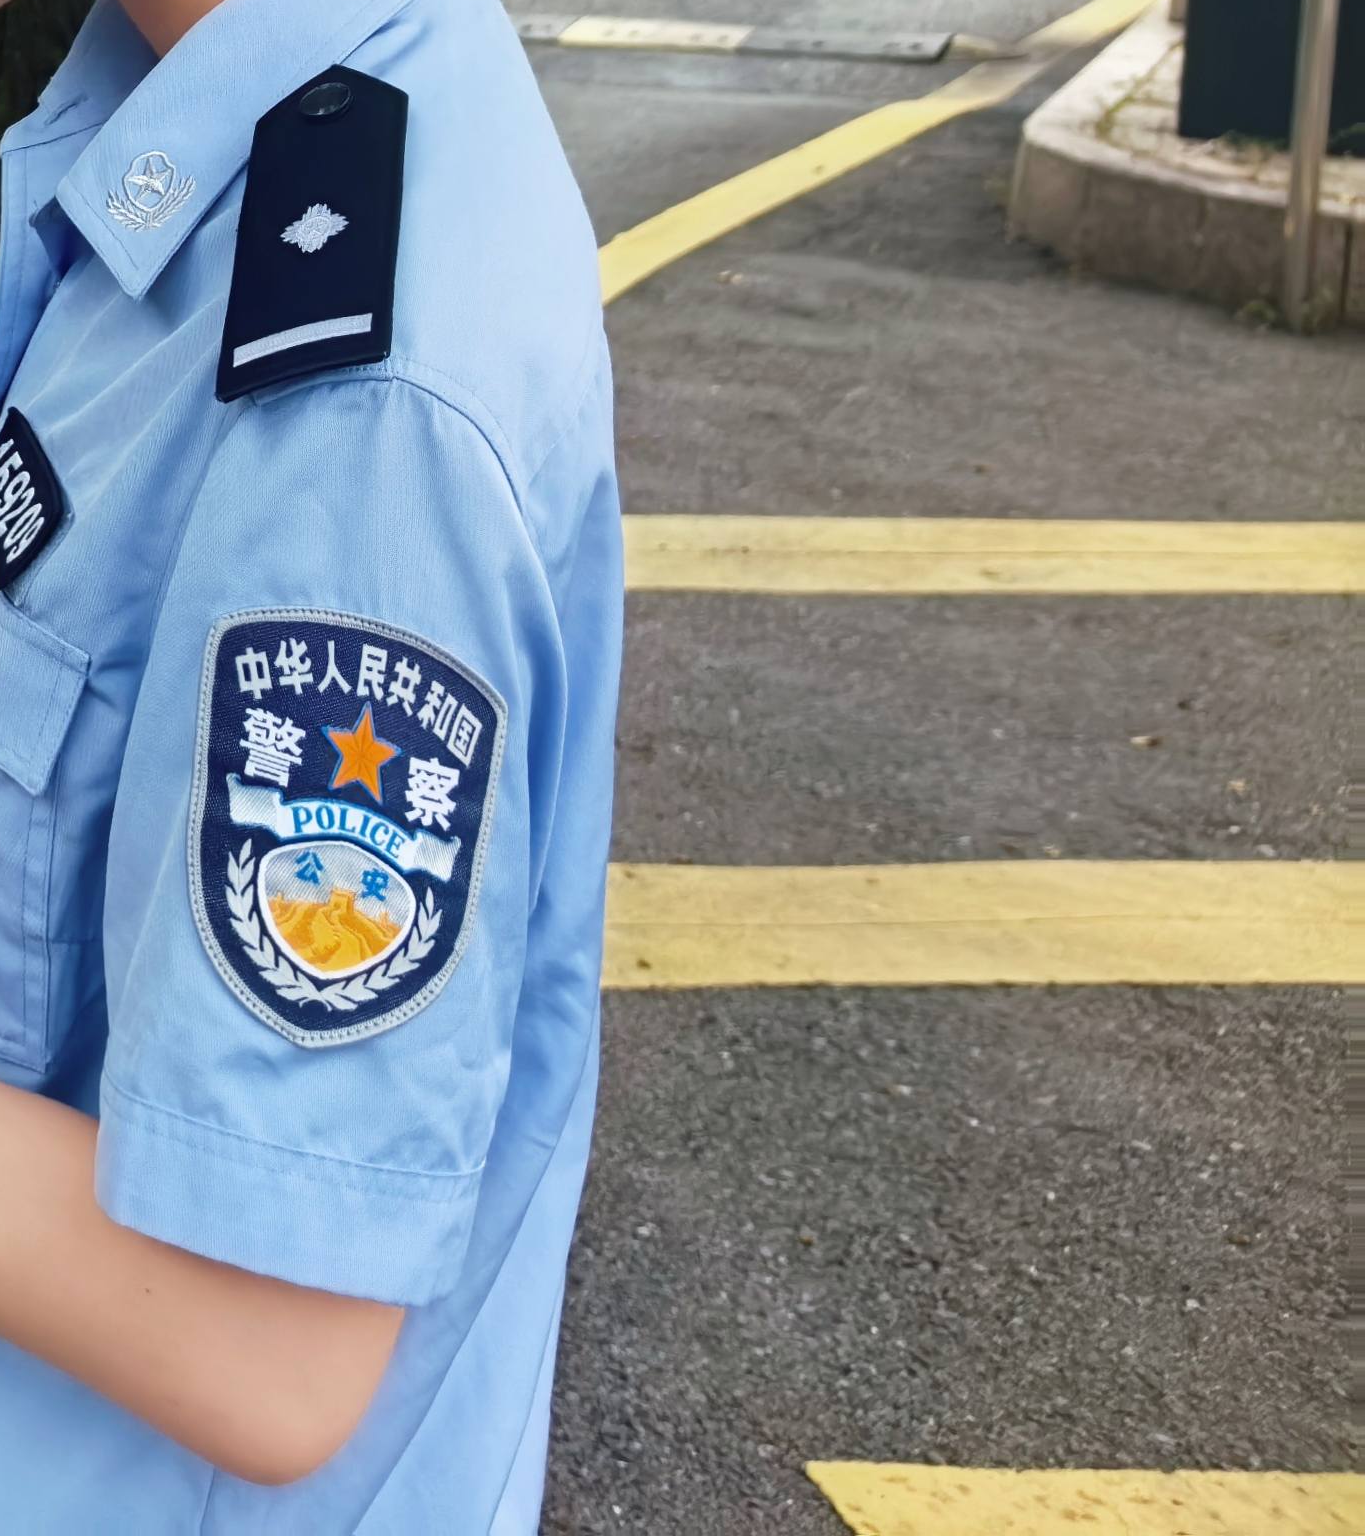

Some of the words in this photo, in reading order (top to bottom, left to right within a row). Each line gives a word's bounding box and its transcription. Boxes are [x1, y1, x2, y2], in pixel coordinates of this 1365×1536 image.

[234, 637, 483, 767] 中华人民共和国
[291, 803, 407, 861] POLICE
